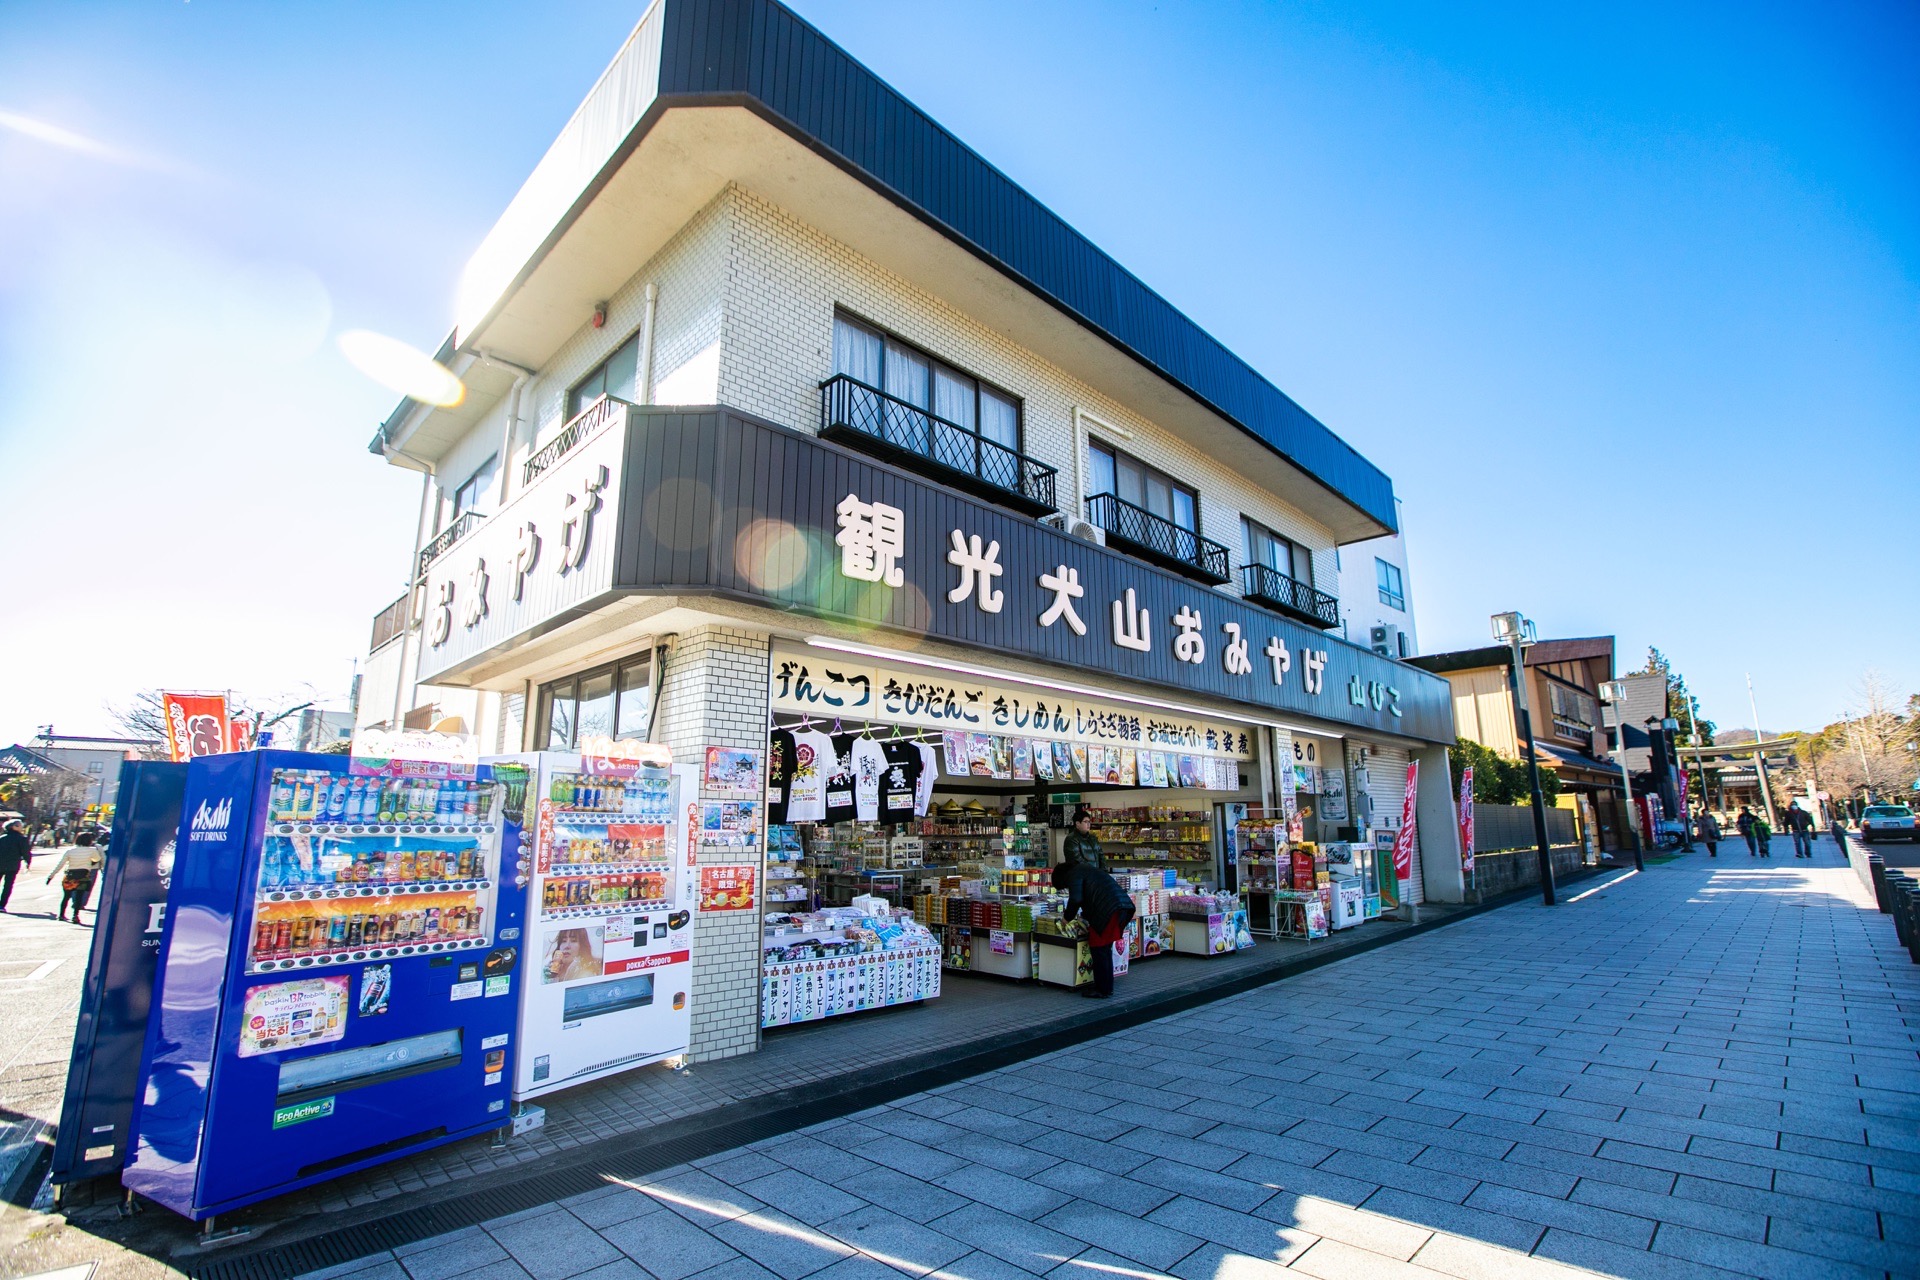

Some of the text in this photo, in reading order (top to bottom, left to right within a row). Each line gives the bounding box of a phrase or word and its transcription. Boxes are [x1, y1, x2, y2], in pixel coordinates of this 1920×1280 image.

[429, 464, 610, 651] おみやげ
[776, 661, 870, 707] げんこつ
[882, 677, 983, 723] きびだんご
[1348, 674, 1402, 718] 山びこ
[992, 694, 1071, 733] きしめん
[1076, 707, 1142, 742] しらさぎ物語
[1146, 719, 1202, 748] 古城せんべい
[191, 796, 233, 831] Asahi
[189, 831, 228, 842] SOFT DRINKS
[781, 979, 789, 1019] Tシャツ
[256, 1025, 289, 1040] 当たる!
[277, 1105, 320, 1123] Eco Active
